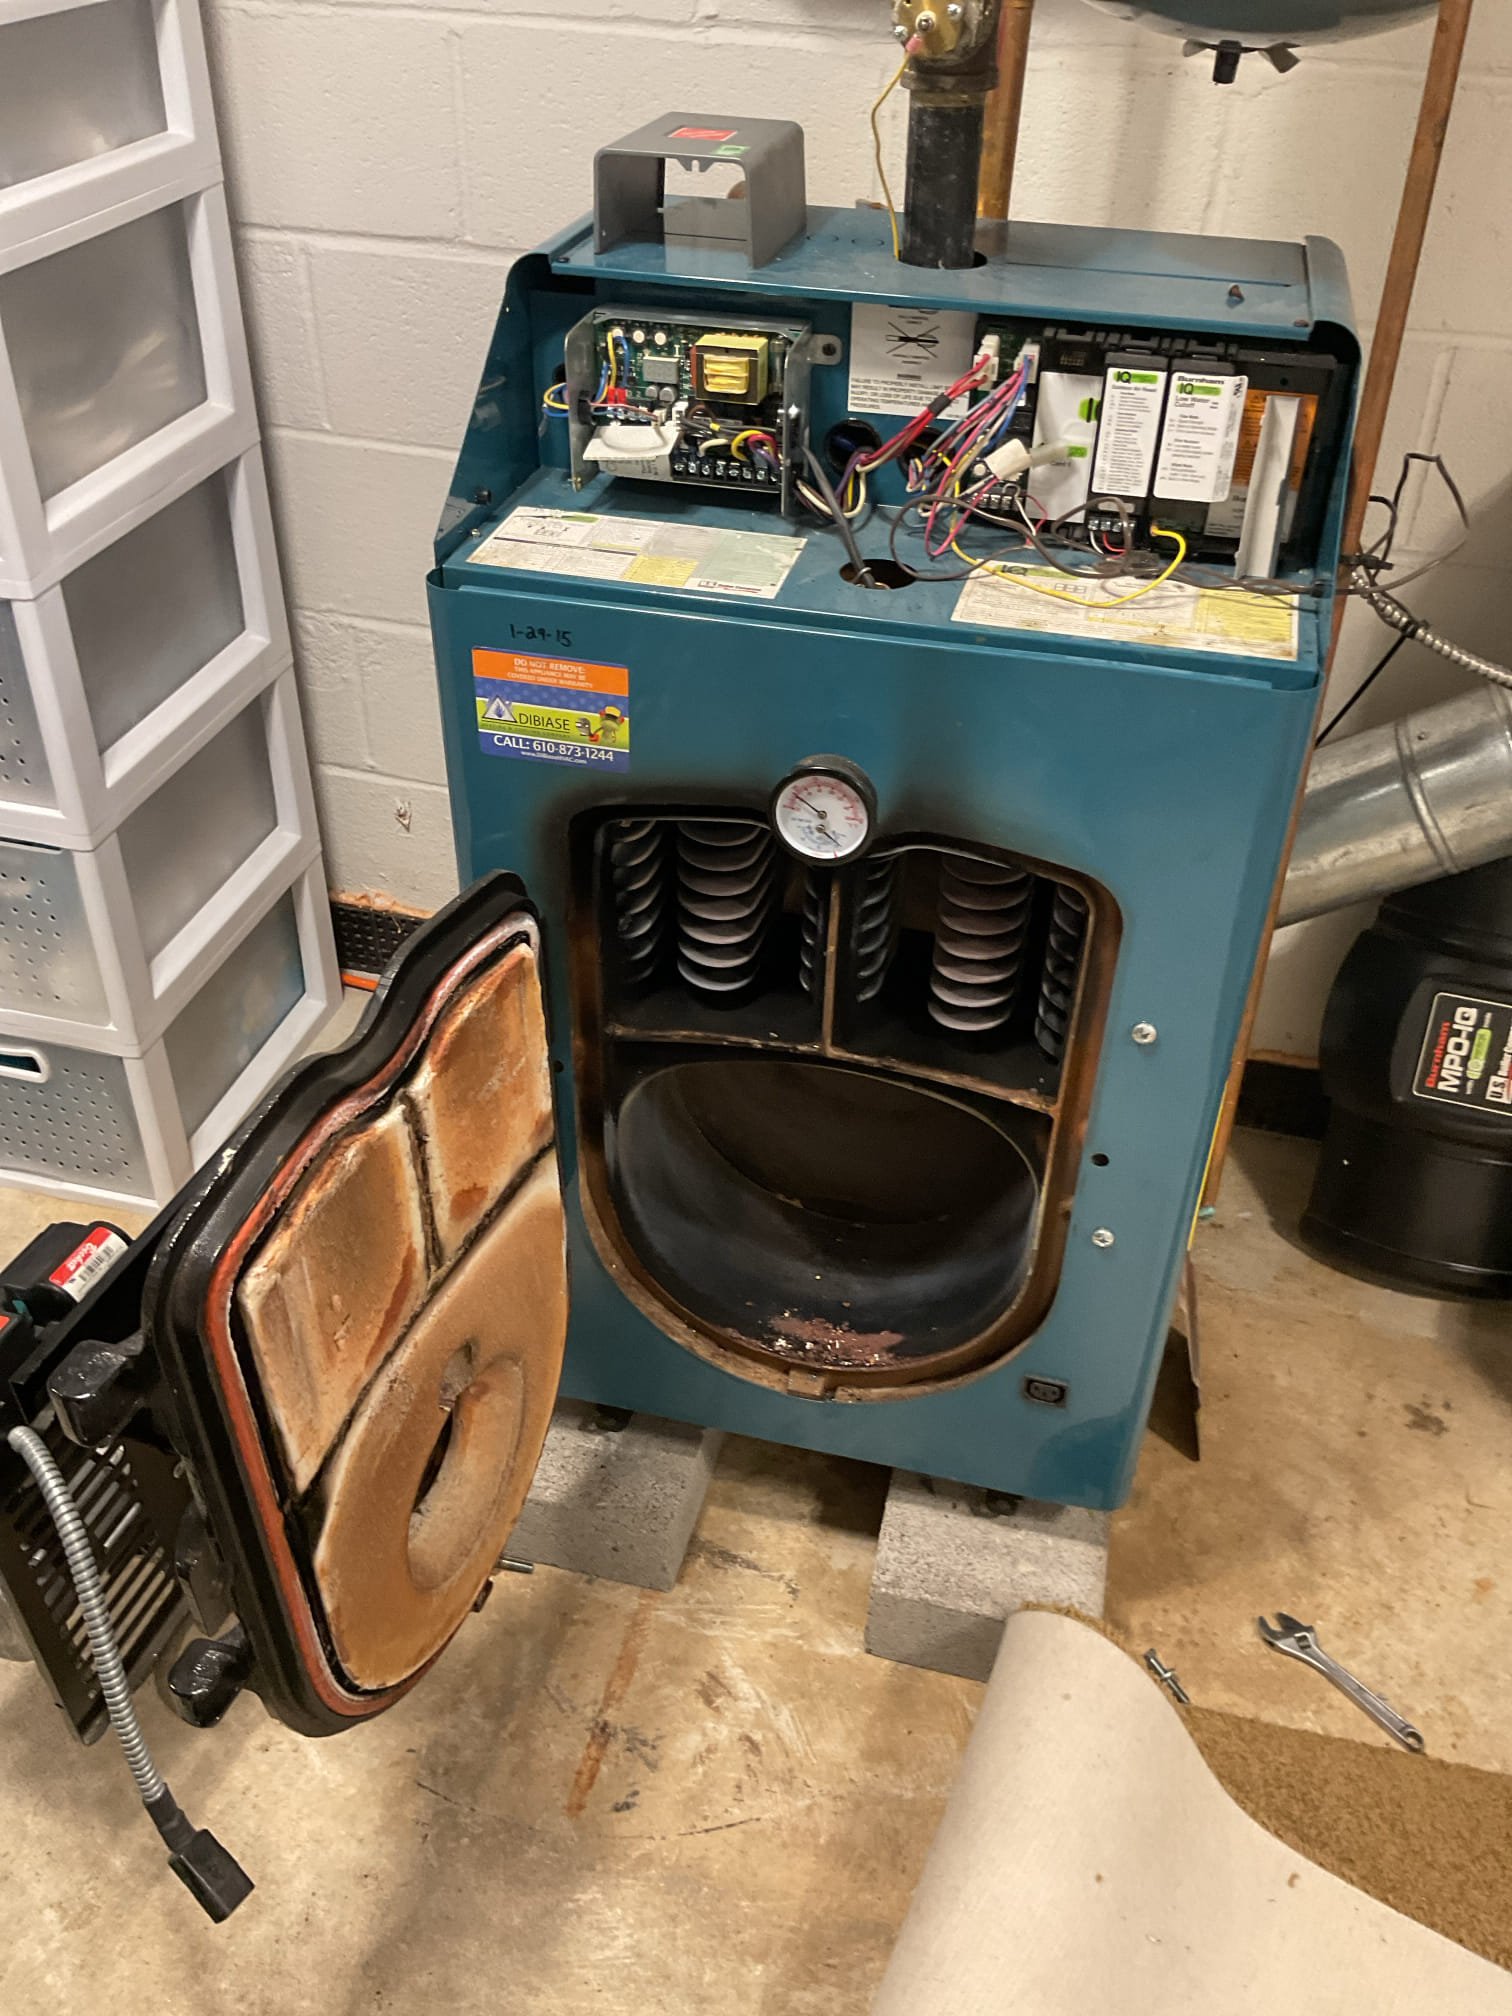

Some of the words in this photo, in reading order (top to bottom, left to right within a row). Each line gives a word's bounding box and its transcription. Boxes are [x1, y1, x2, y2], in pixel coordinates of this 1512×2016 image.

[1116, 371, 1132, 384] IQ
[1178, 376, 1224, 385] Burnham
[1180, 383, 1193, 395] IQ
[509, 623, 572, 648] 1-29-15
[513, 658, 528, 668] DO
[518, 712, 571, 731] DIBIASE
[493, 734, 530, 750] CALL:
[533, 740, 614, 762] 610-873-1244
[1425, 1021, 1452, 1088] Burnham
[1437, 1006, 1478, 1093] MPO-IQ
